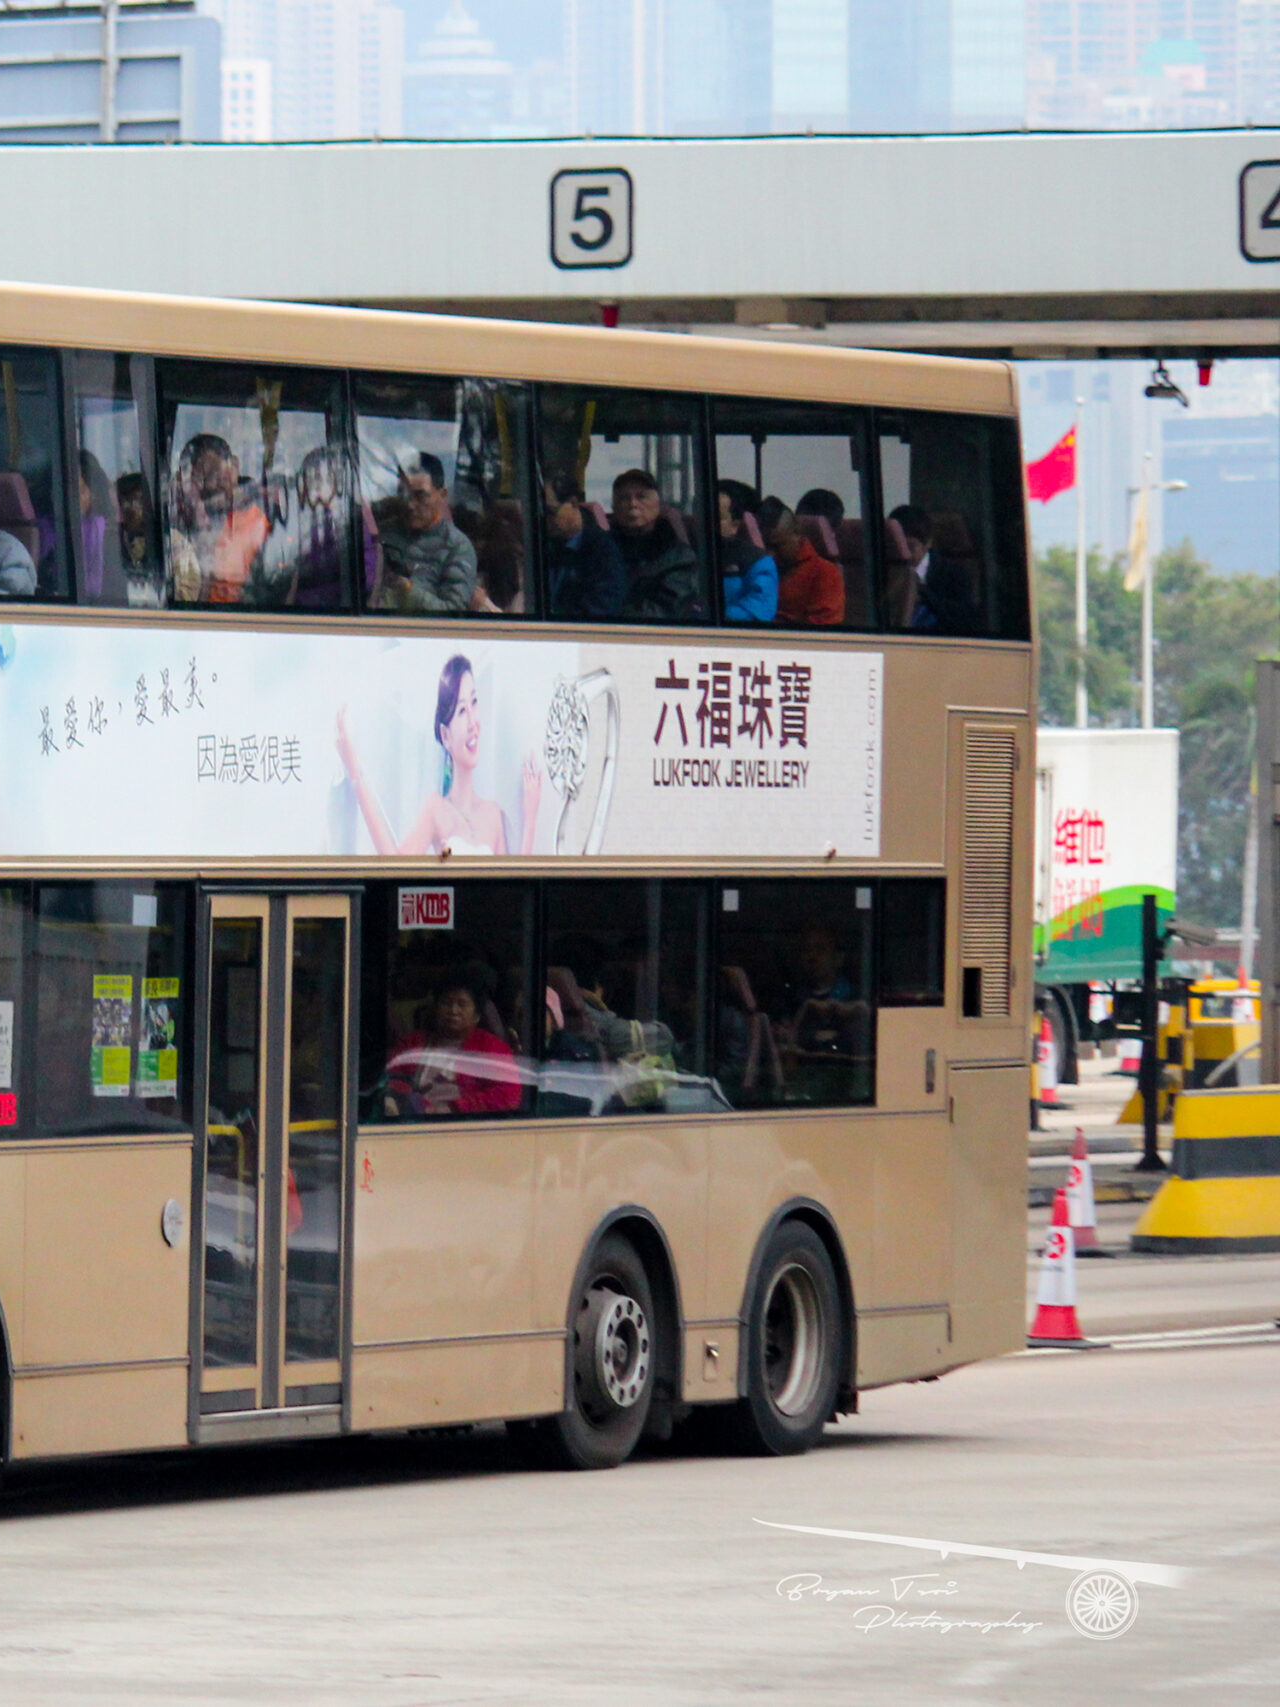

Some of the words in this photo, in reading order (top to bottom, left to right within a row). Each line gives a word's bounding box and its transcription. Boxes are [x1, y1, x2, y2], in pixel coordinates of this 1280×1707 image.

[571, 187, 614, 251] 5
[653, 658, 812, 749] 六福珠寶
[196, 734, 302, 784] 因為愛很美
[653, 758, 721, 788] LUKFOOK
[725, 759, 810, 788] JEWELLERY
[864, 668, 878, 840] lukfook.com
[416, 892, 451, 925] KMB
